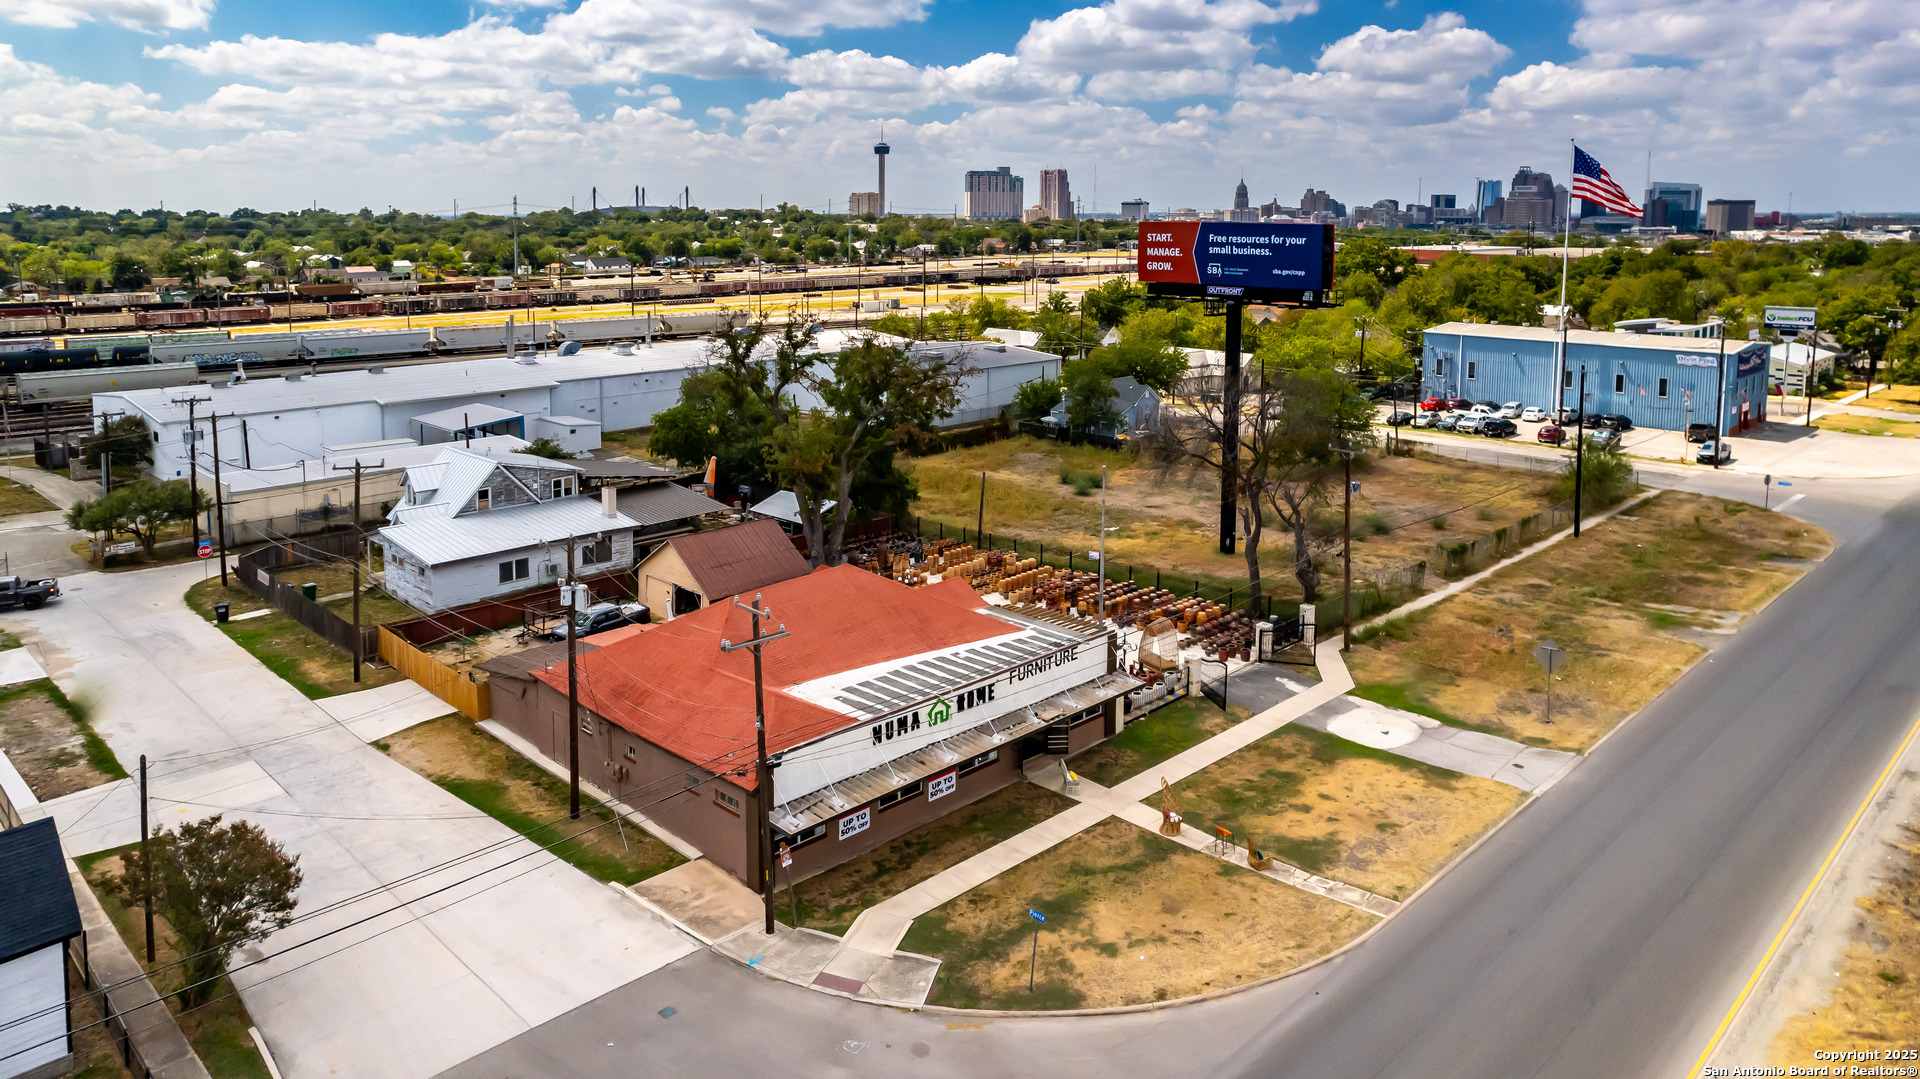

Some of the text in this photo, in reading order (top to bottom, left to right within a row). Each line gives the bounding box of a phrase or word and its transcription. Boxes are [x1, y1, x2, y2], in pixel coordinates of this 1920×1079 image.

[1147, 233, 1173, 242] START.
[1209, 234, 1306, 246] Free resources for your
[1146, 247, 1183, 256] MANAGE.
[1208, 246, 1272, 256] small business.
[1146, 262, 1173, 271] GROW.
[1207, 266, 1222, 275] SBA
[1208, 287, 1242, 295] OUTFRONT
[1009, 647, 1078, 684] FURNITURE
[872, 682, 995, 746] NUMA HOME
[931, 775, 953, 790] UP TO
[930, 786, 945, 799] 50%
[843, 812, 867, 828] UP TO
[840, 821, 868, 837] 50% OFF
